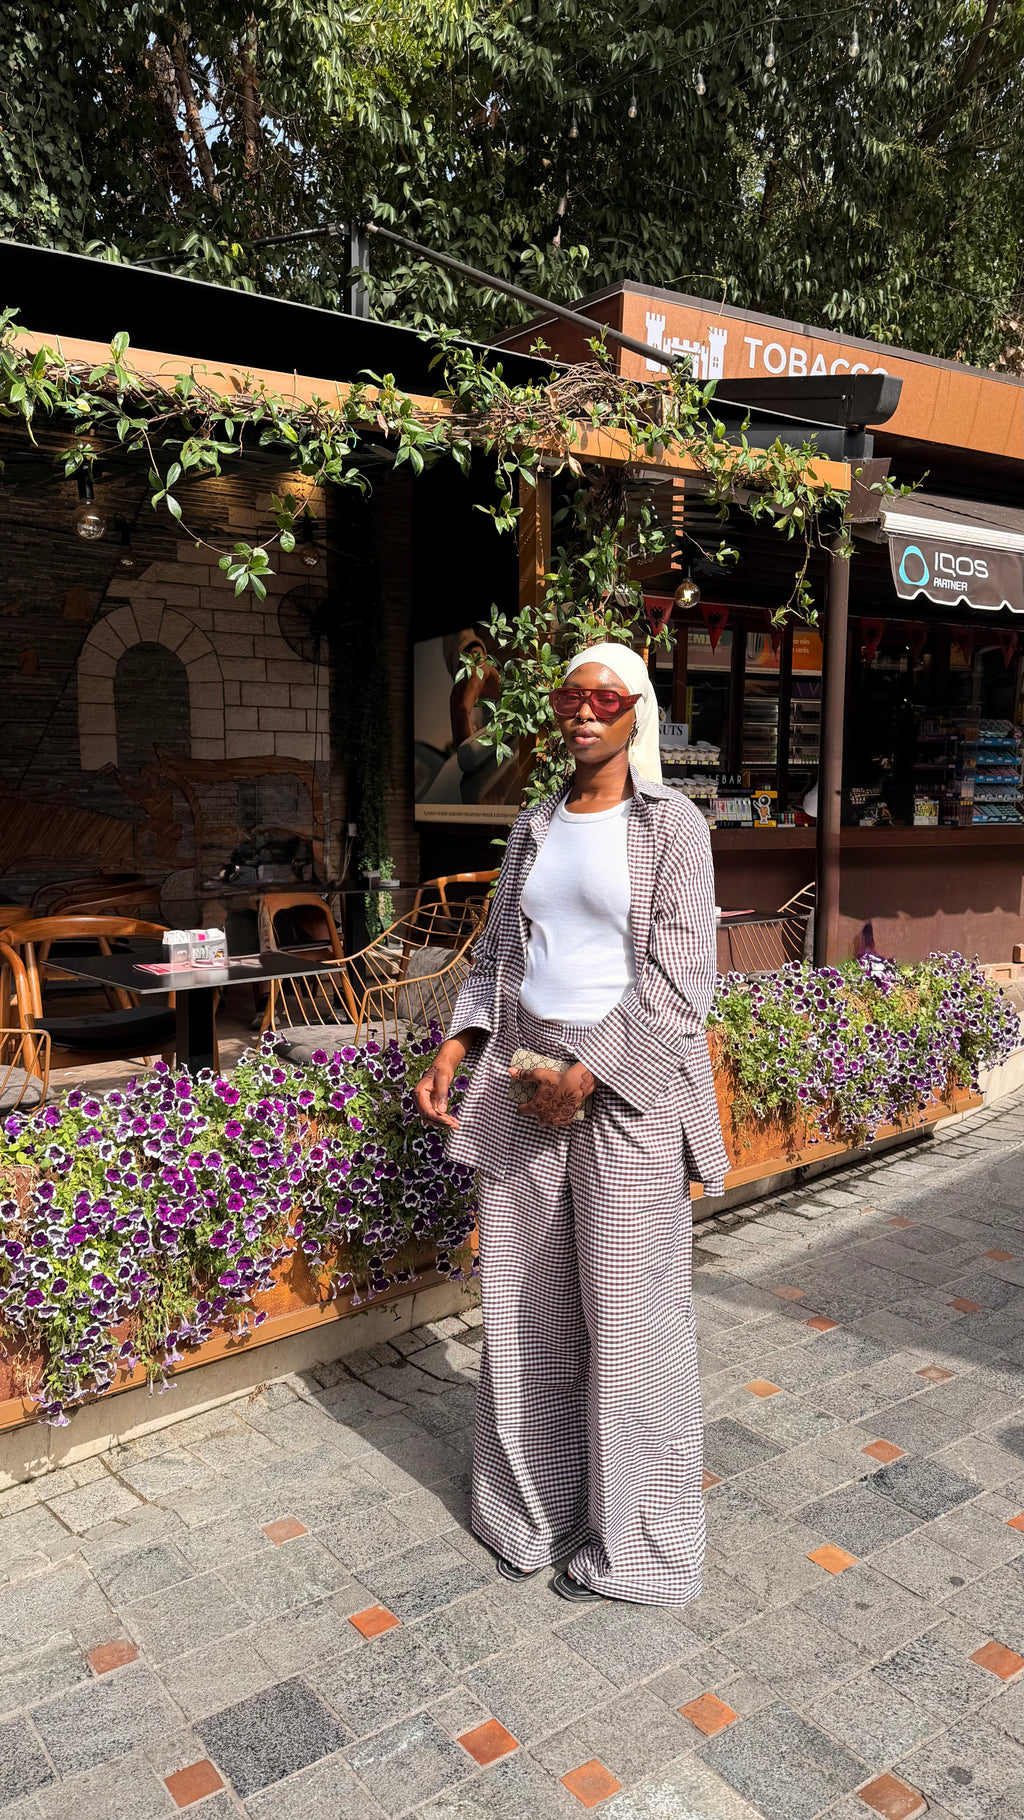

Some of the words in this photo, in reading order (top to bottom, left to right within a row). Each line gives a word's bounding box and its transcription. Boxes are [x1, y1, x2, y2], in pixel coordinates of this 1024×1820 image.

[743, 336, 889, 377] TOBAC
[934, 551, 989, 579] IQOS
[933, 577, 968, 592] PARTNER
